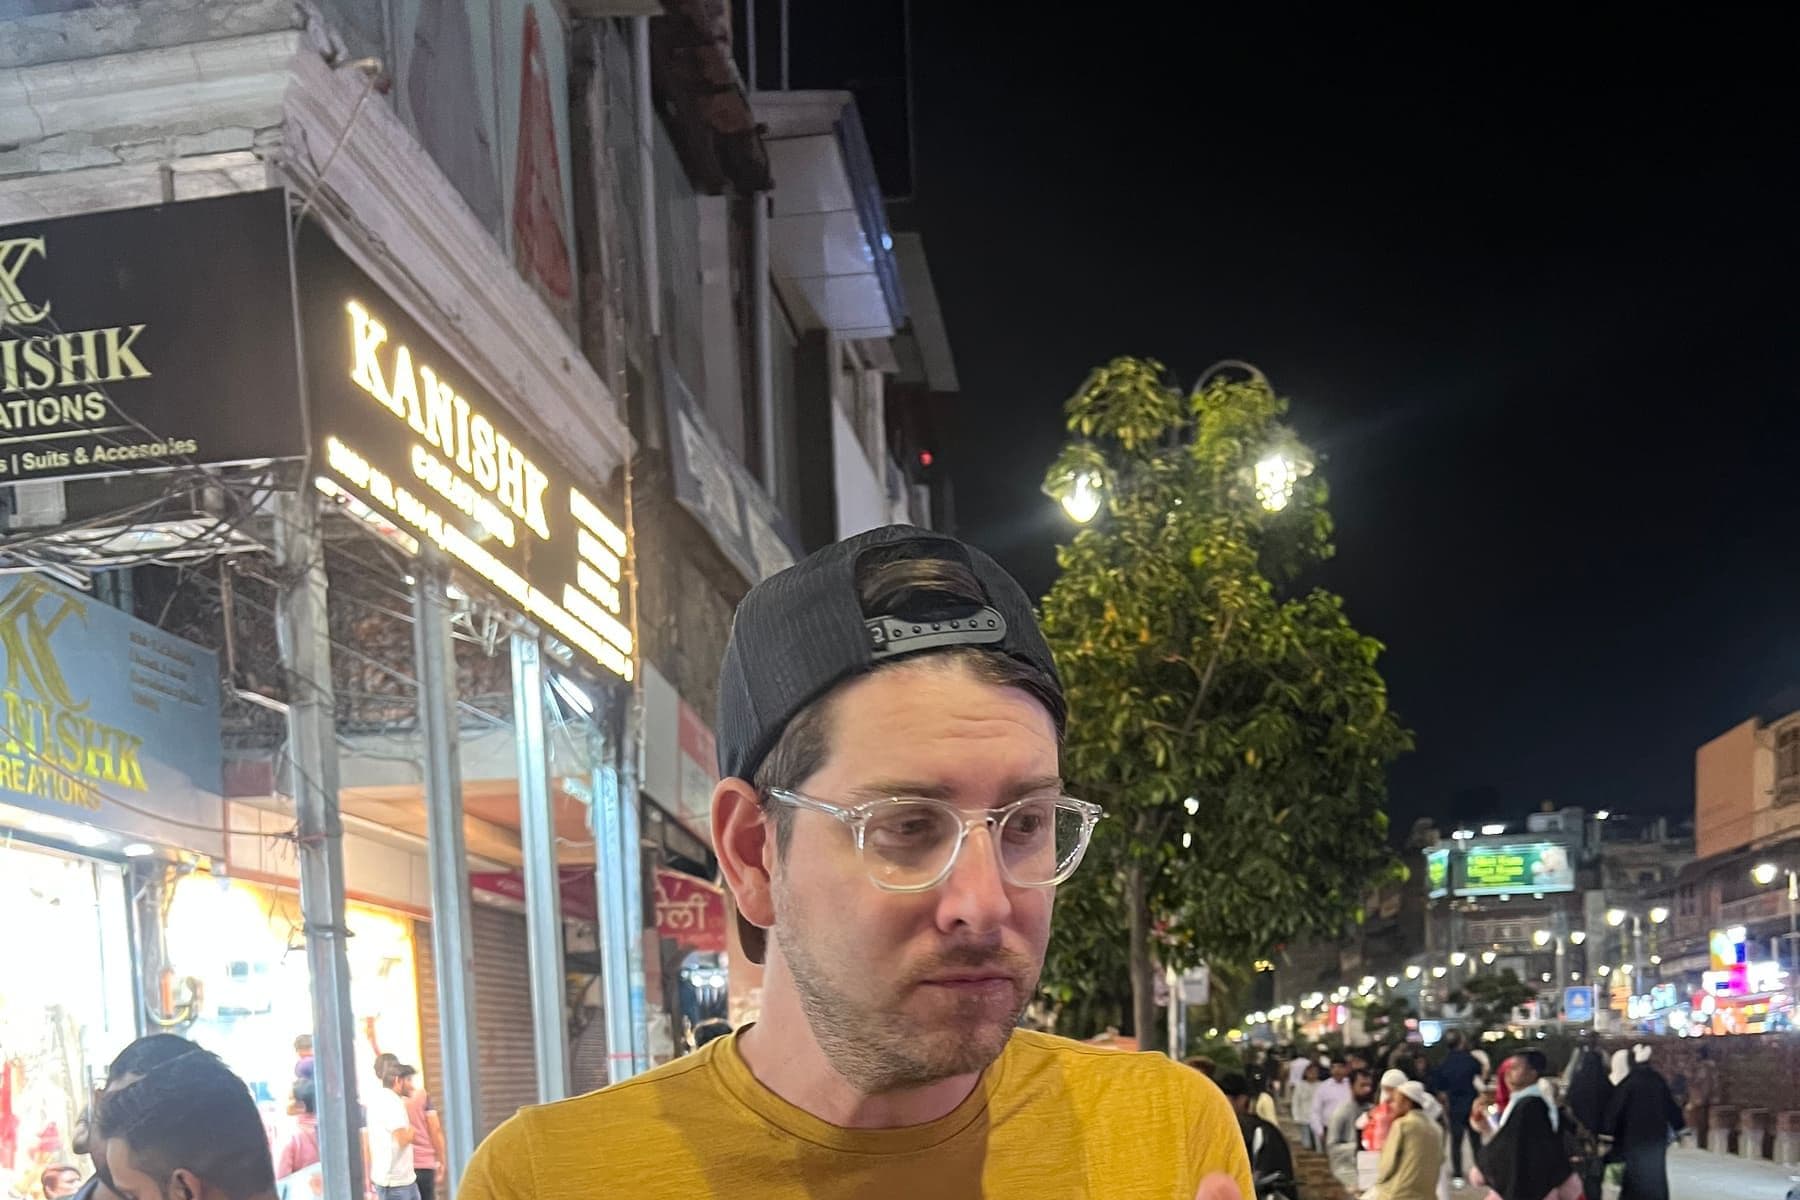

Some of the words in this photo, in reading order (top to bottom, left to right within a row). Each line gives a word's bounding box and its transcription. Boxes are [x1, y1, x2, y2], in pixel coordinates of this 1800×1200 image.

[22, 451, 70, 470] Suits
[74, 446, 90, 465] &
[346, 300, 550, 541] KANISHK
[0, 688, 149, 793] NISHK
